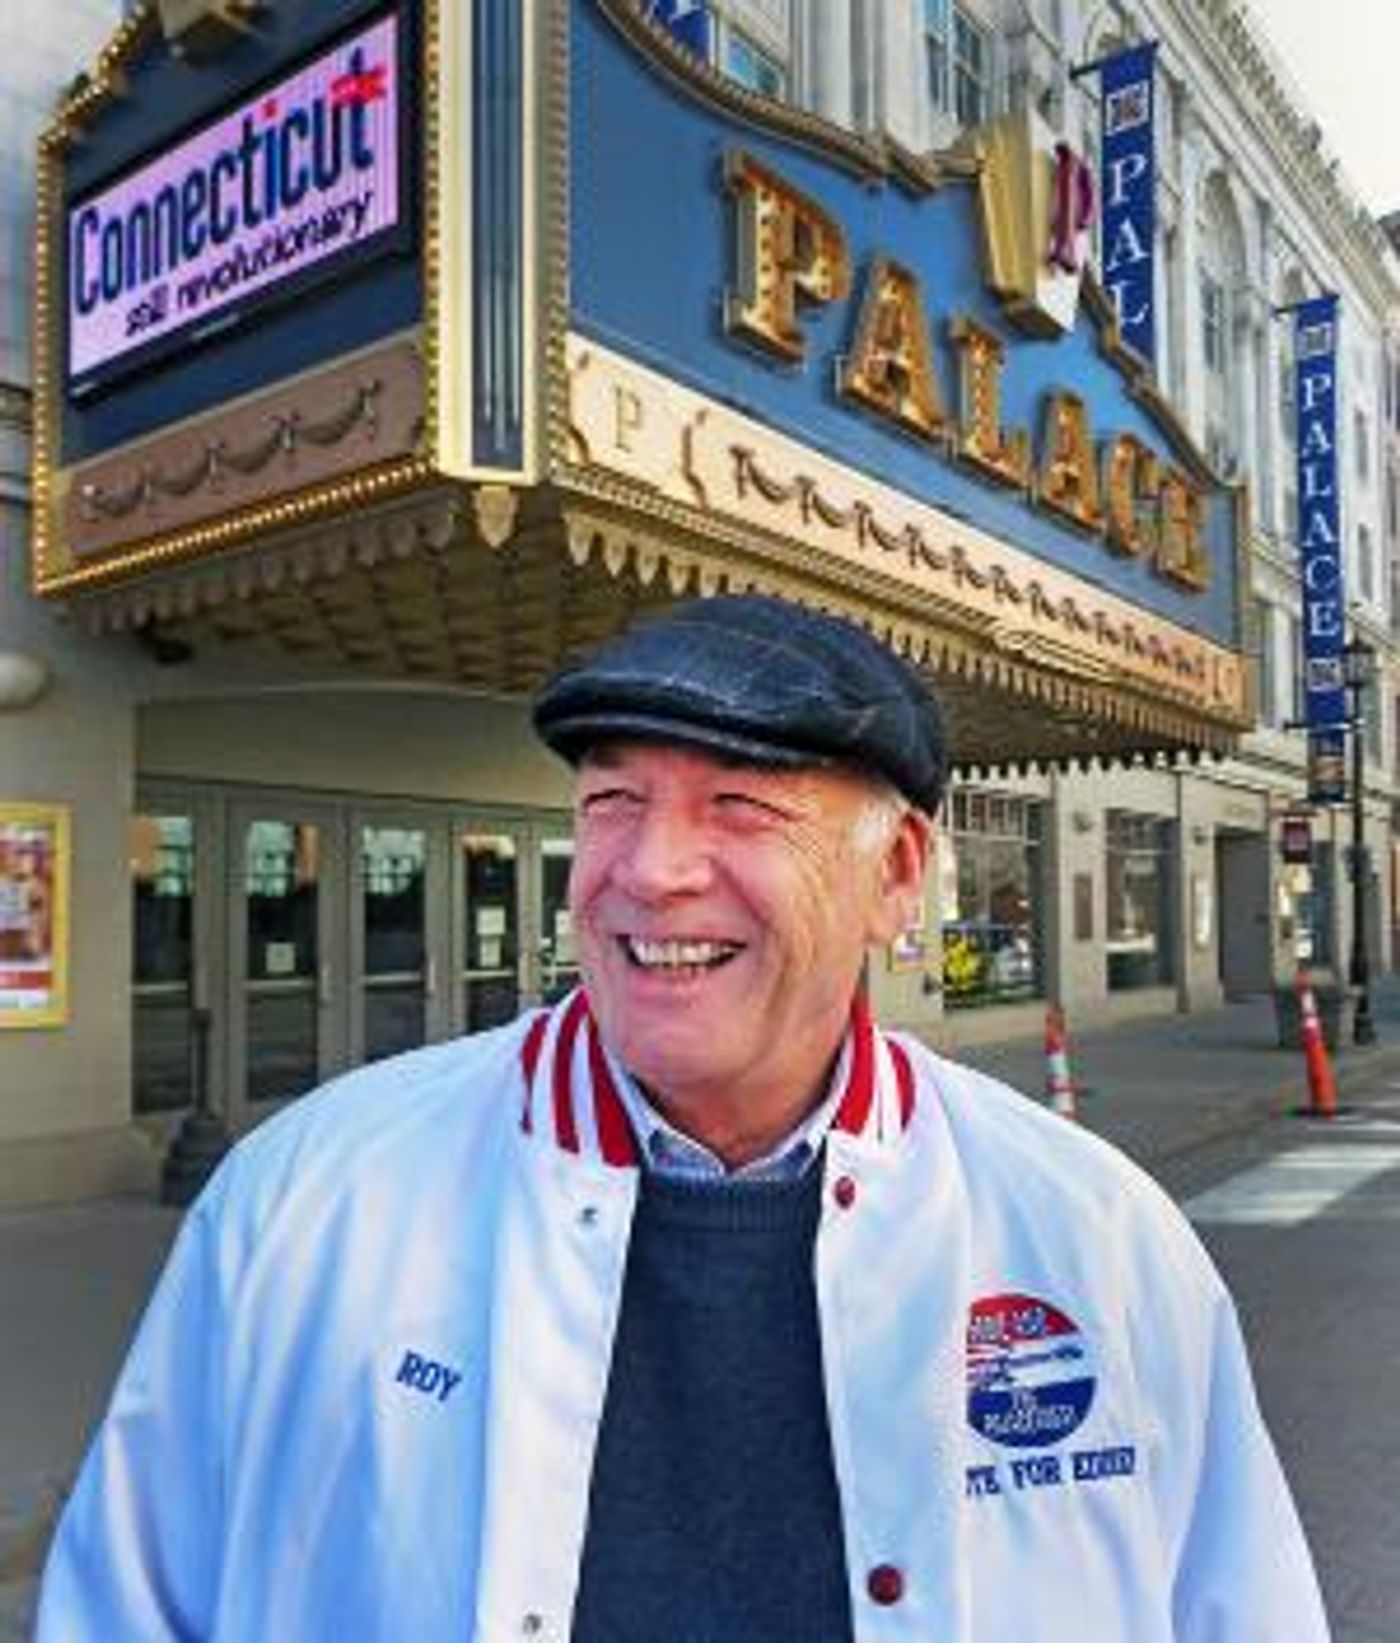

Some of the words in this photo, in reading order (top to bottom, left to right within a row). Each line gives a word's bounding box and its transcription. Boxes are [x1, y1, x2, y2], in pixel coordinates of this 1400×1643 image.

[75, 47, 388, 314] Connecticut
[177, 190, 374, 310] revolutionary
[396, 349, 462, 402] ROY
[614, 383, 643, 452] P
[722, 146, 1208, 592] PALACE
[1302, 374, 1342, 637] PALACE
[1010, 1455, 1063, 1490] FOR
